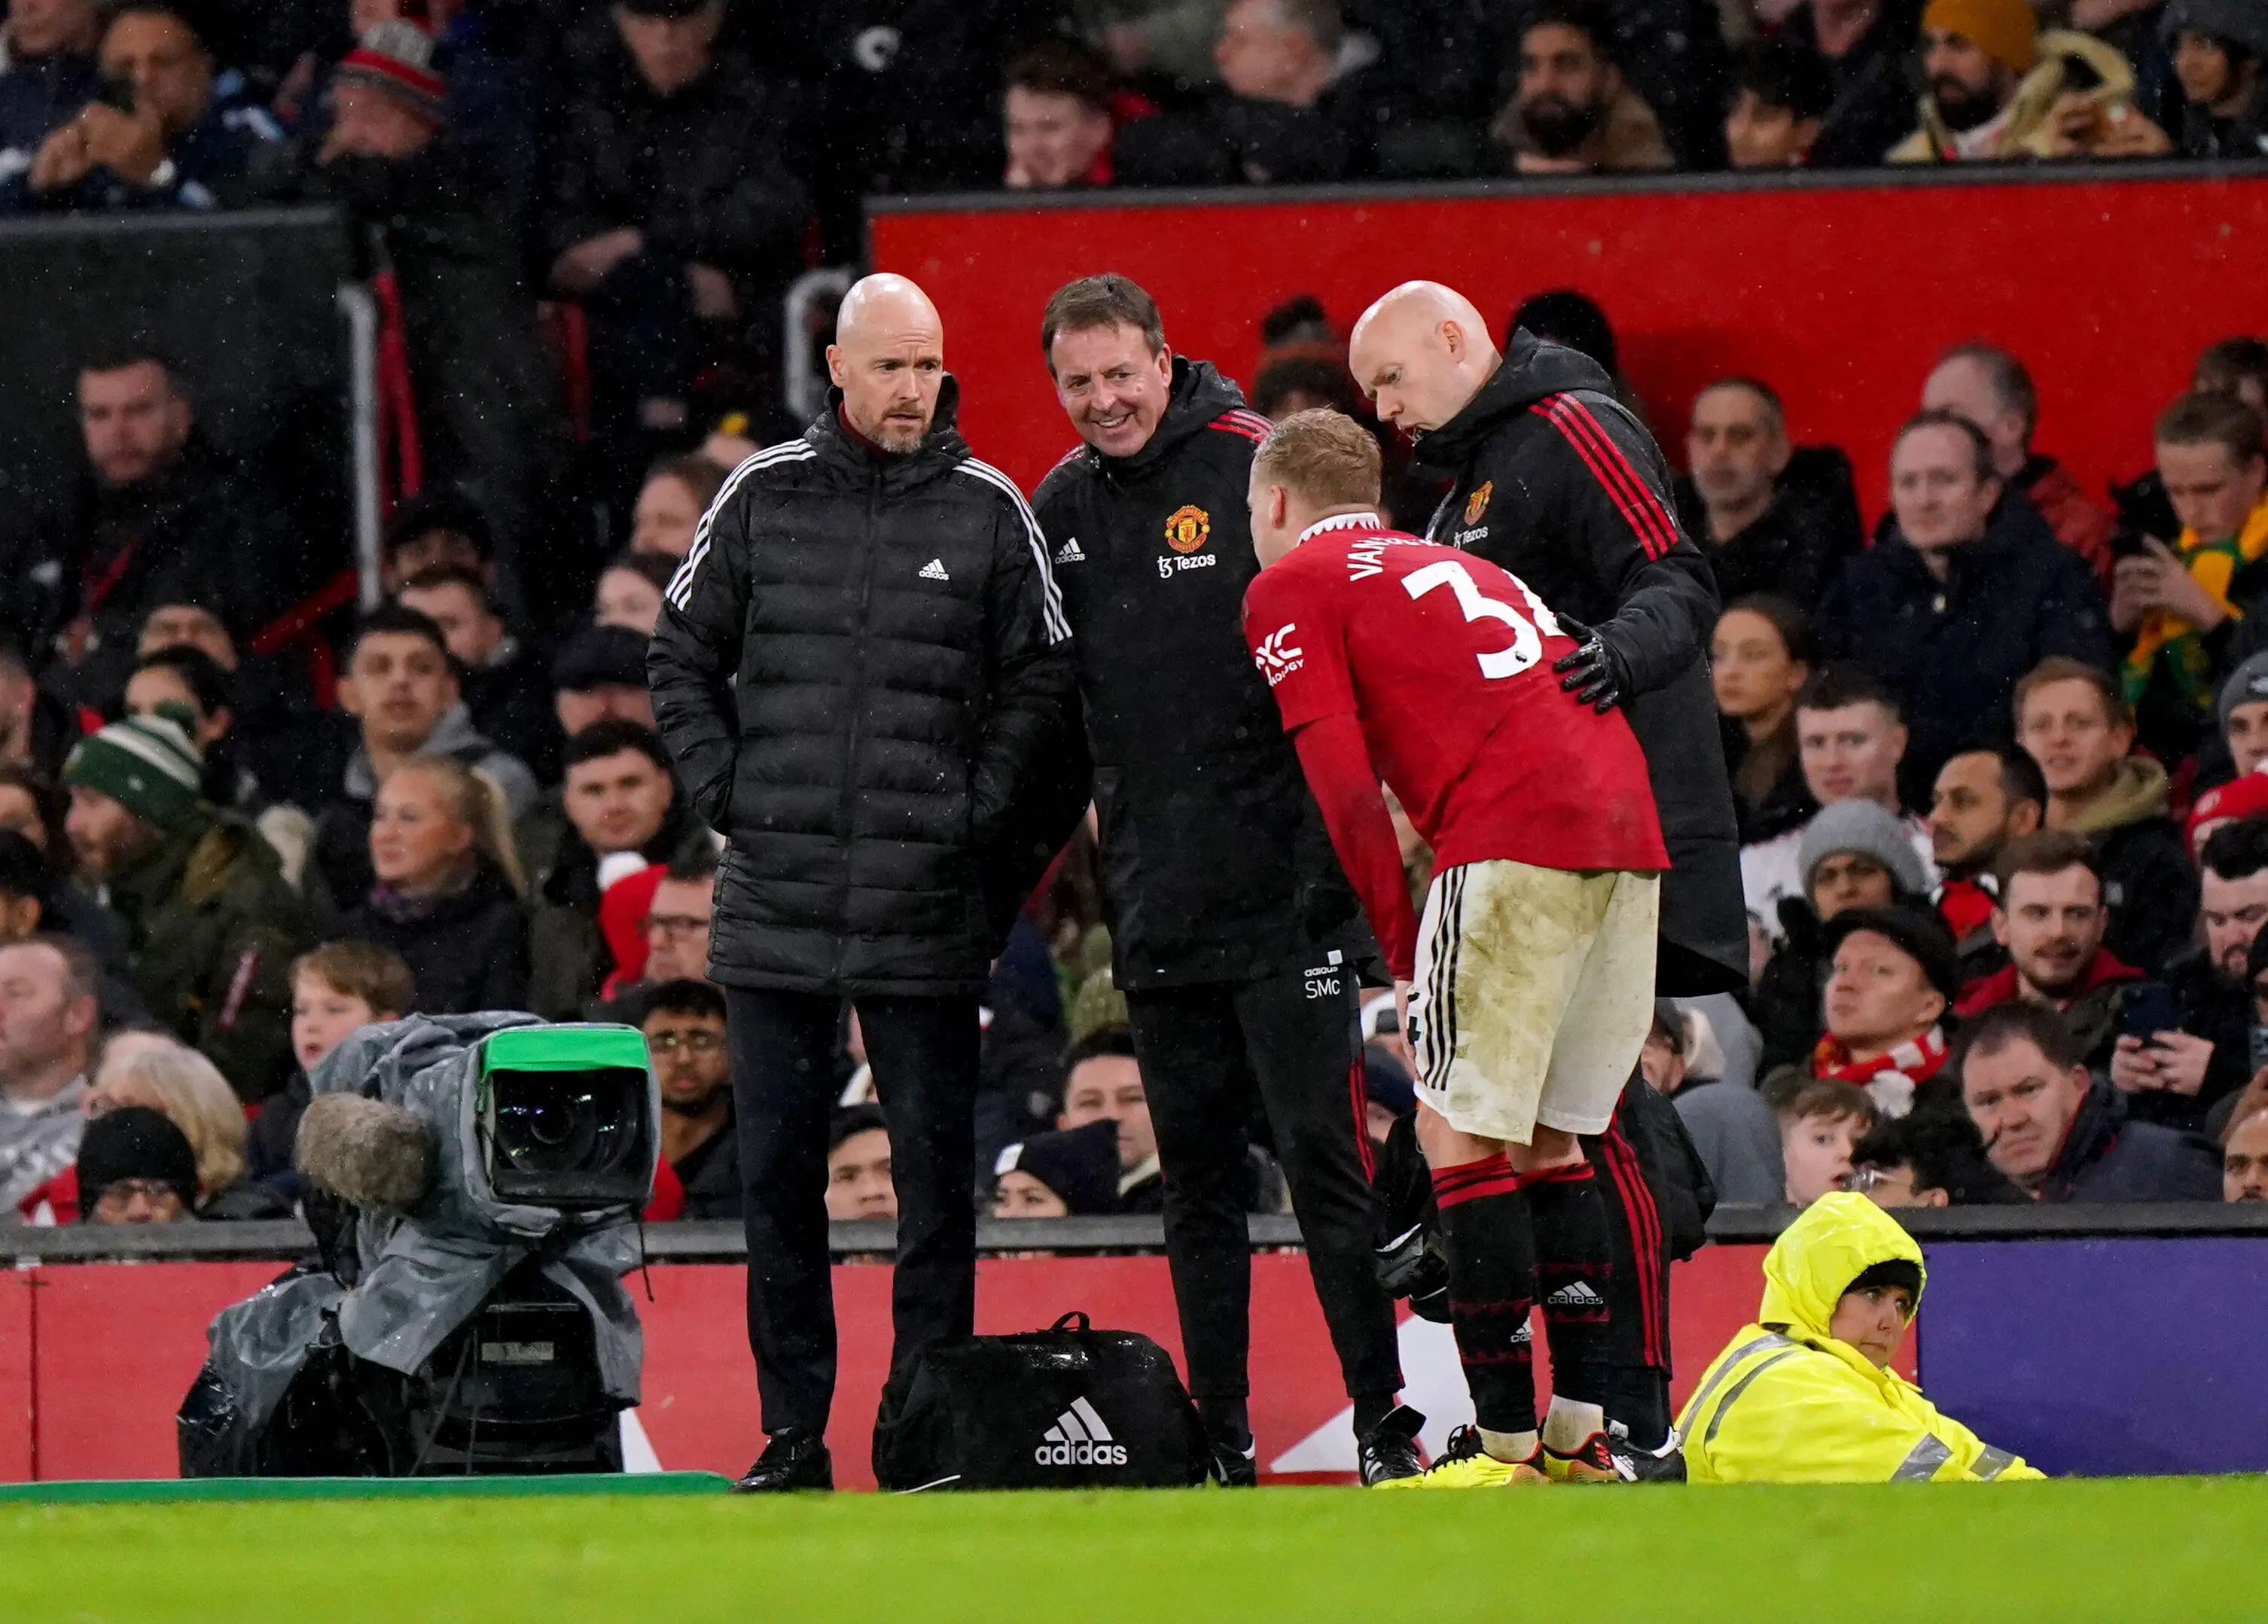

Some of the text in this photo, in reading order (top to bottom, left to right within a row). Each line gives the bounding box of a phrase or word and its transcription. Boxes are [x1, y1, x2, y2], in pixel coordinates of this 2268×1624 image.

[1055, 552, 1086, 564] adidas
[1173, 554, 1216, 571] Tezos
[919, 570, 950, 581] adidas
[1547, 1295, 1604, 1305] adidas
[1035, 1439, 1128, 1466] adidas
